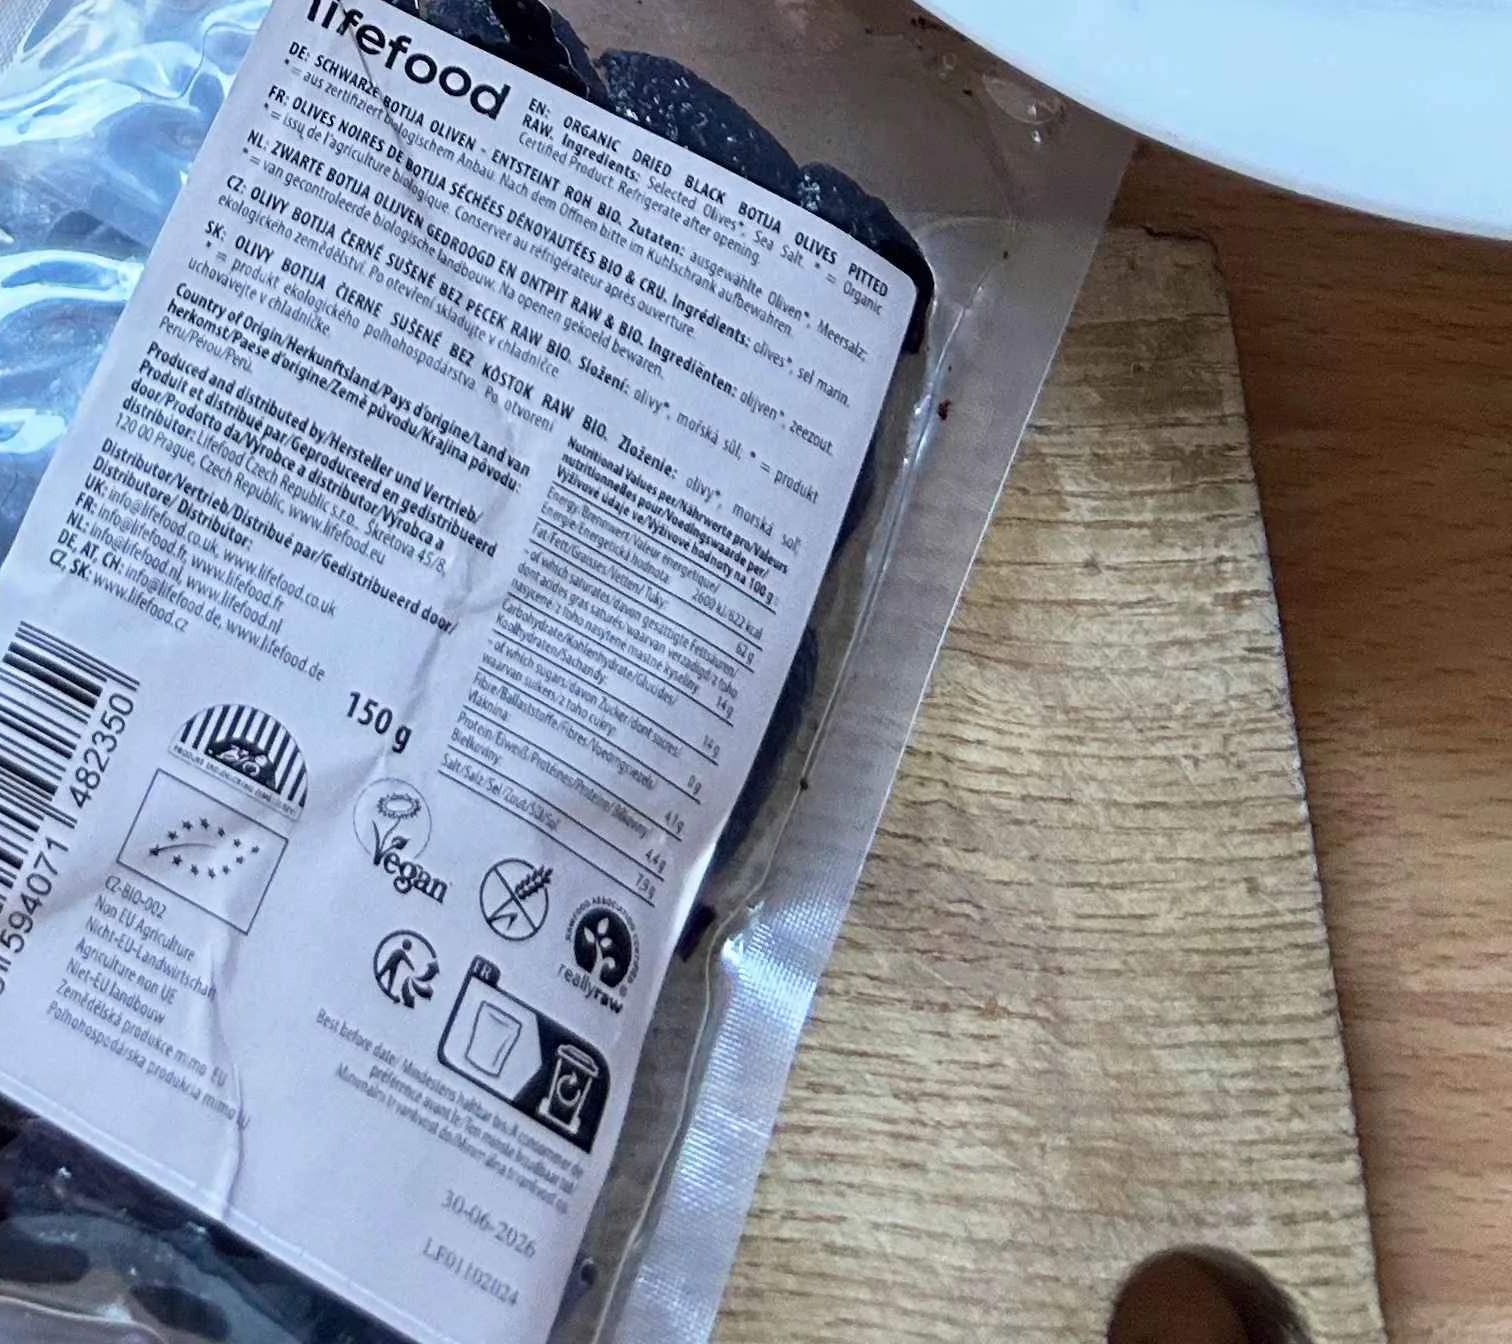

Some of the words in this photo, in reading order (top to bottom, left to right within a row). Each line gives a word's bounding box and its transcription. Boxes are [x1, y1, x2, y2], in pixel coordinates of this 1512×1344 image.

[268, 85, 286, 105] FR:
[292, 97, 336, 127] OLIVES
[338, 119, 385, 152] NOIRES
[387, 145, 403, 163] DE
[405, 157, 446, 191] BOTIJA
[449, 182, 504, 218] SÉCHÉES
[506, 209, 596, 264] DÉNOYAUTÉES
[598, 255, 623, 277] BIO
[639, 278, 667, 302] CRU.
[672, 293, 750, 348] Ingrédients:
[529, 98, 550, 118] EN:
[563, 116, 621, 152] ORGANIC
[632, 148, 672, 177] DRIED
[684, 174, 726, 204] BLACK
[738, 201, 781, 234] BOTIJA
[794, 232, 837, 265] OLIVES
[848, 263, 888, 297] PITTED
[147, 341, 209, 381] Produced
[208, 375, 236, 395] and
[236, 386, 309, 433] distributed
[395, 471, 422, 493] und
[423, 482, 481, 524] Vertrieb/
[85, 473, 108, 497] UK:
[224, 548, 336, 616] www.lifefood.co.uk
[347, 692, 393, 735] 150
[392, 726, 412, 754] g
[0, 837, 69, 954] 594071
[69, 694, 134, 808] 482350
[373, 822, 448, 904] Vegan
[105, 875, 166, 920] CZ-BIO-002
[558, 964, 623, 1014] reallyraw
[440, 1188, 537, 1259] 30-06-2026
